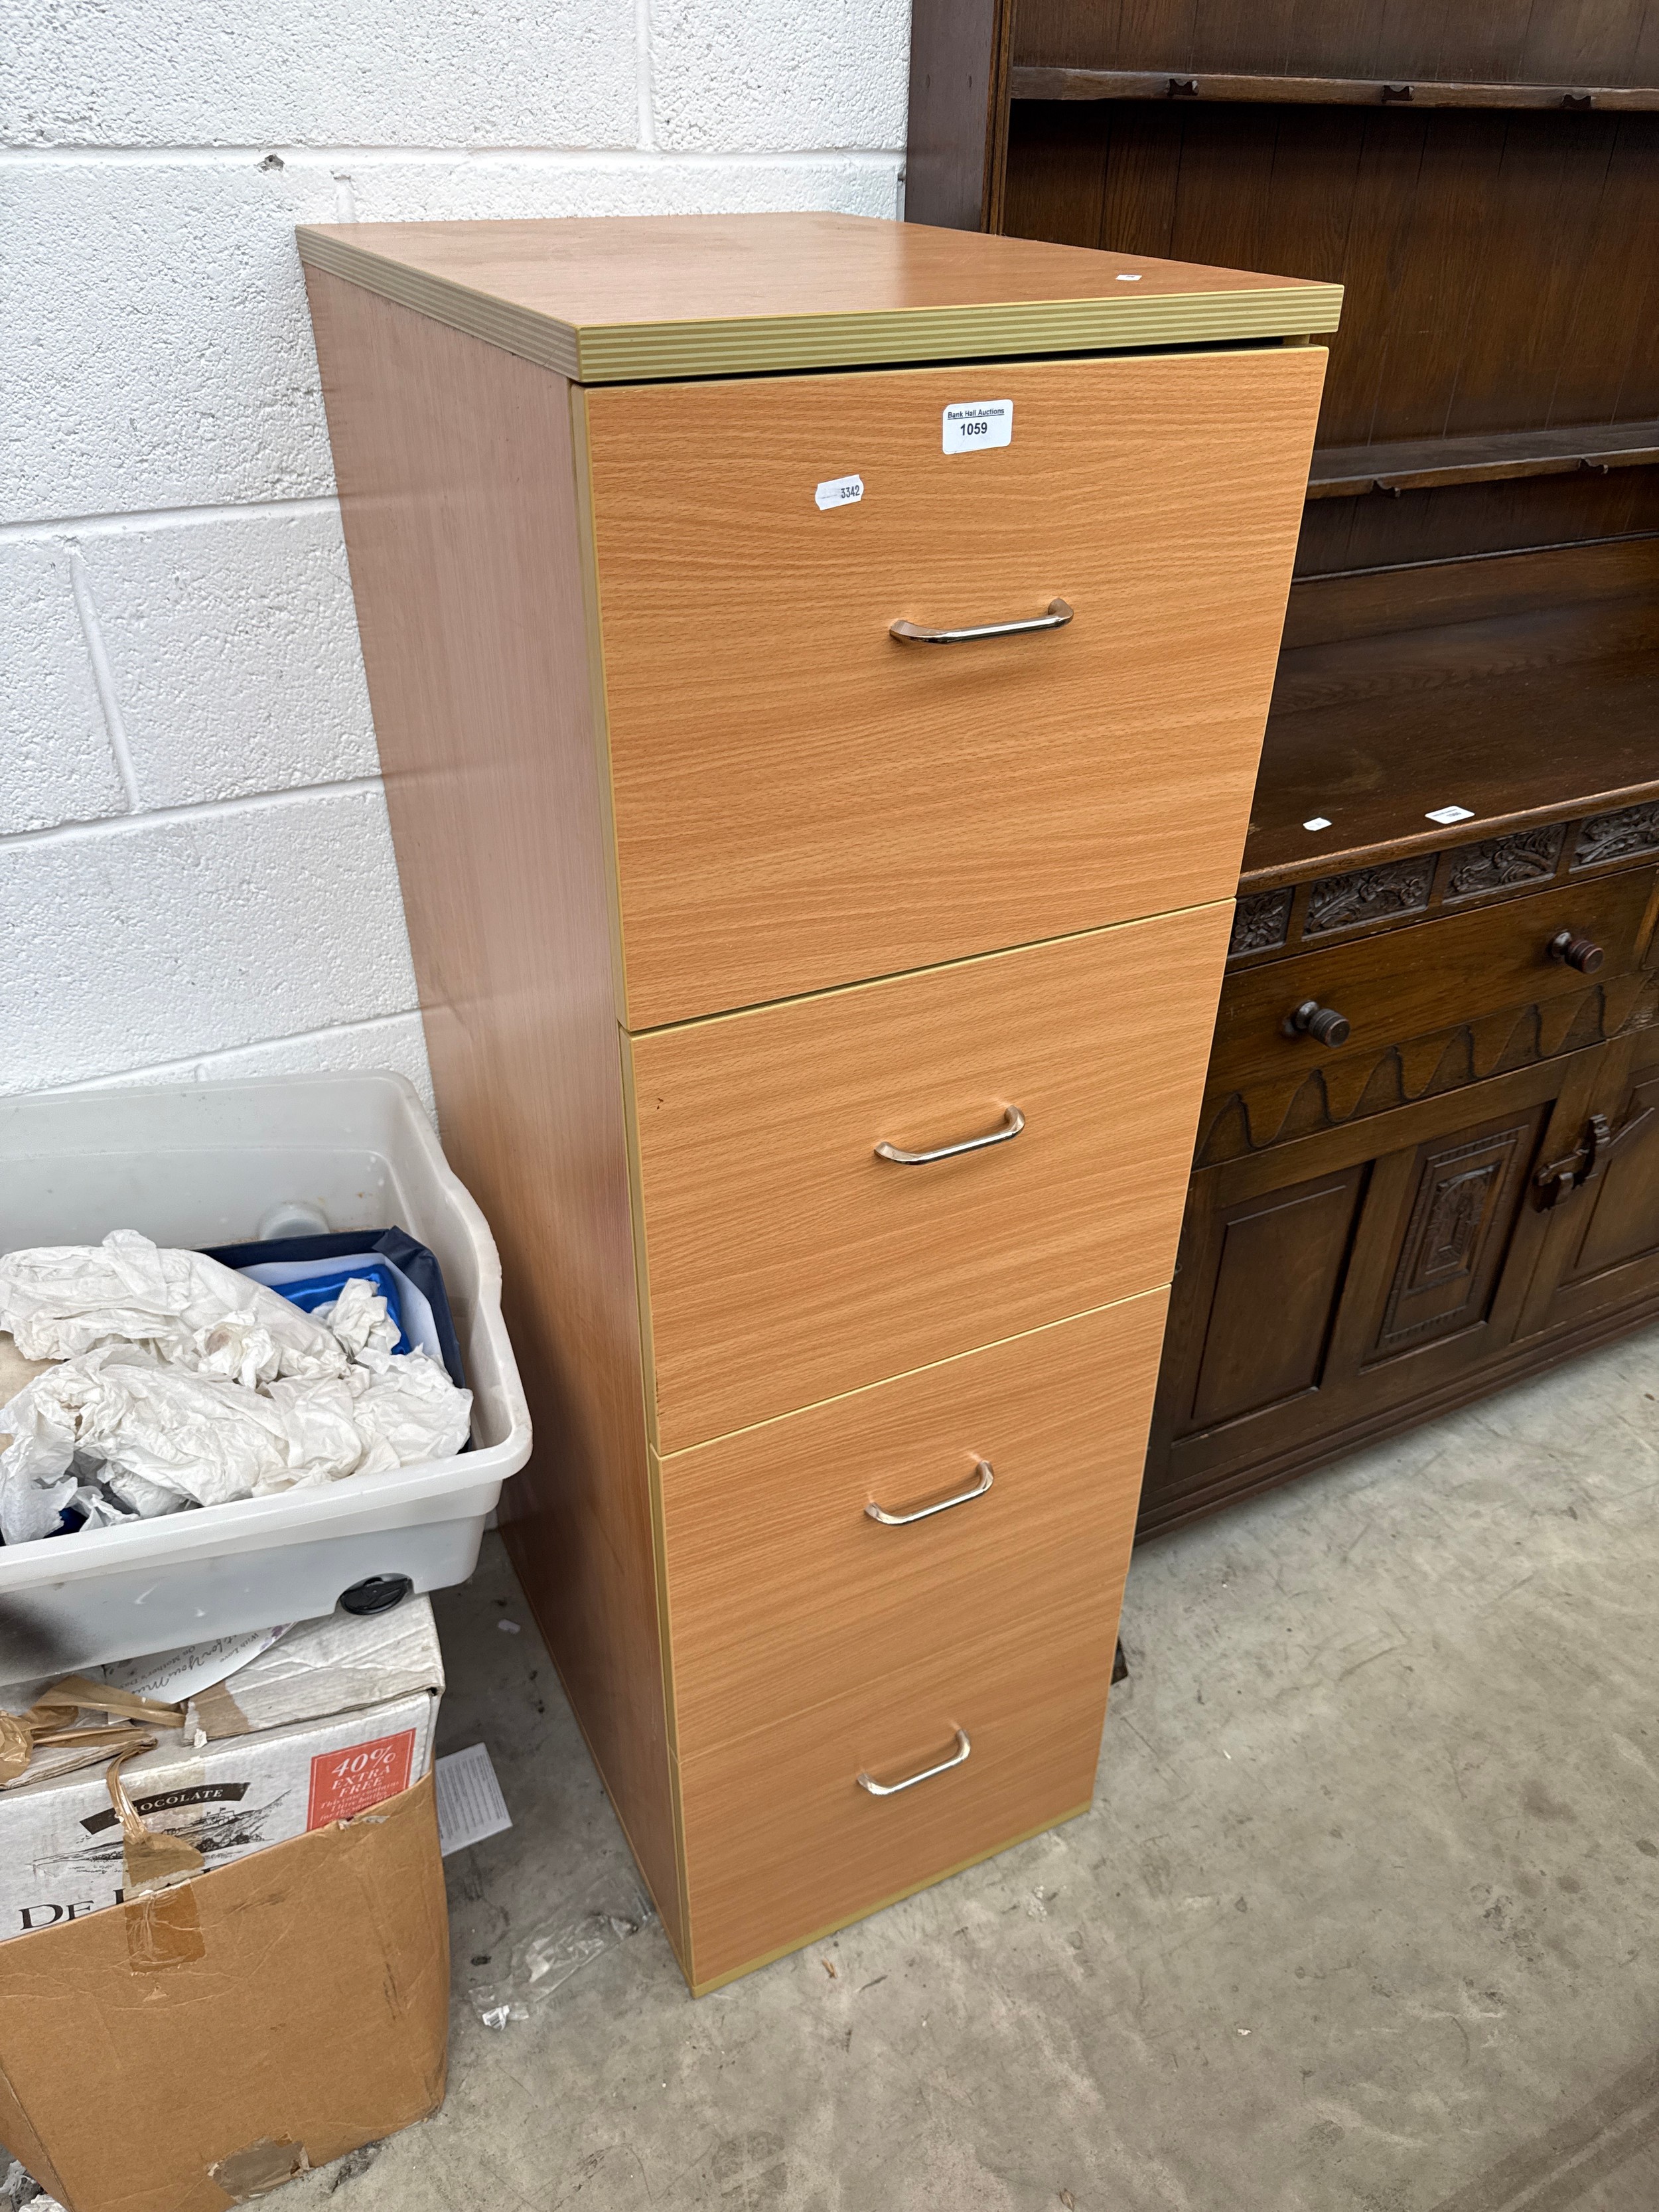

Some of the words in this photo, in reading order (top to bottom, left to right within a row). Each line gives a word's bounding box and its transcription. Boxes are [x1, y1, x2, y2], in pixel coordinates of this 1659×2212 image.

[948, 411, 964, 419] Bank
[960, 421, 988, 436] 1059
[841, 484, 861, 499] 3342
[332, 1744, 397, 1777] 40%
[332, 1765, 391, 1791] EXTRA
[339, 1775, 385, 1798] FREE
[135, 1788, 224, 1813] OCOLATE
